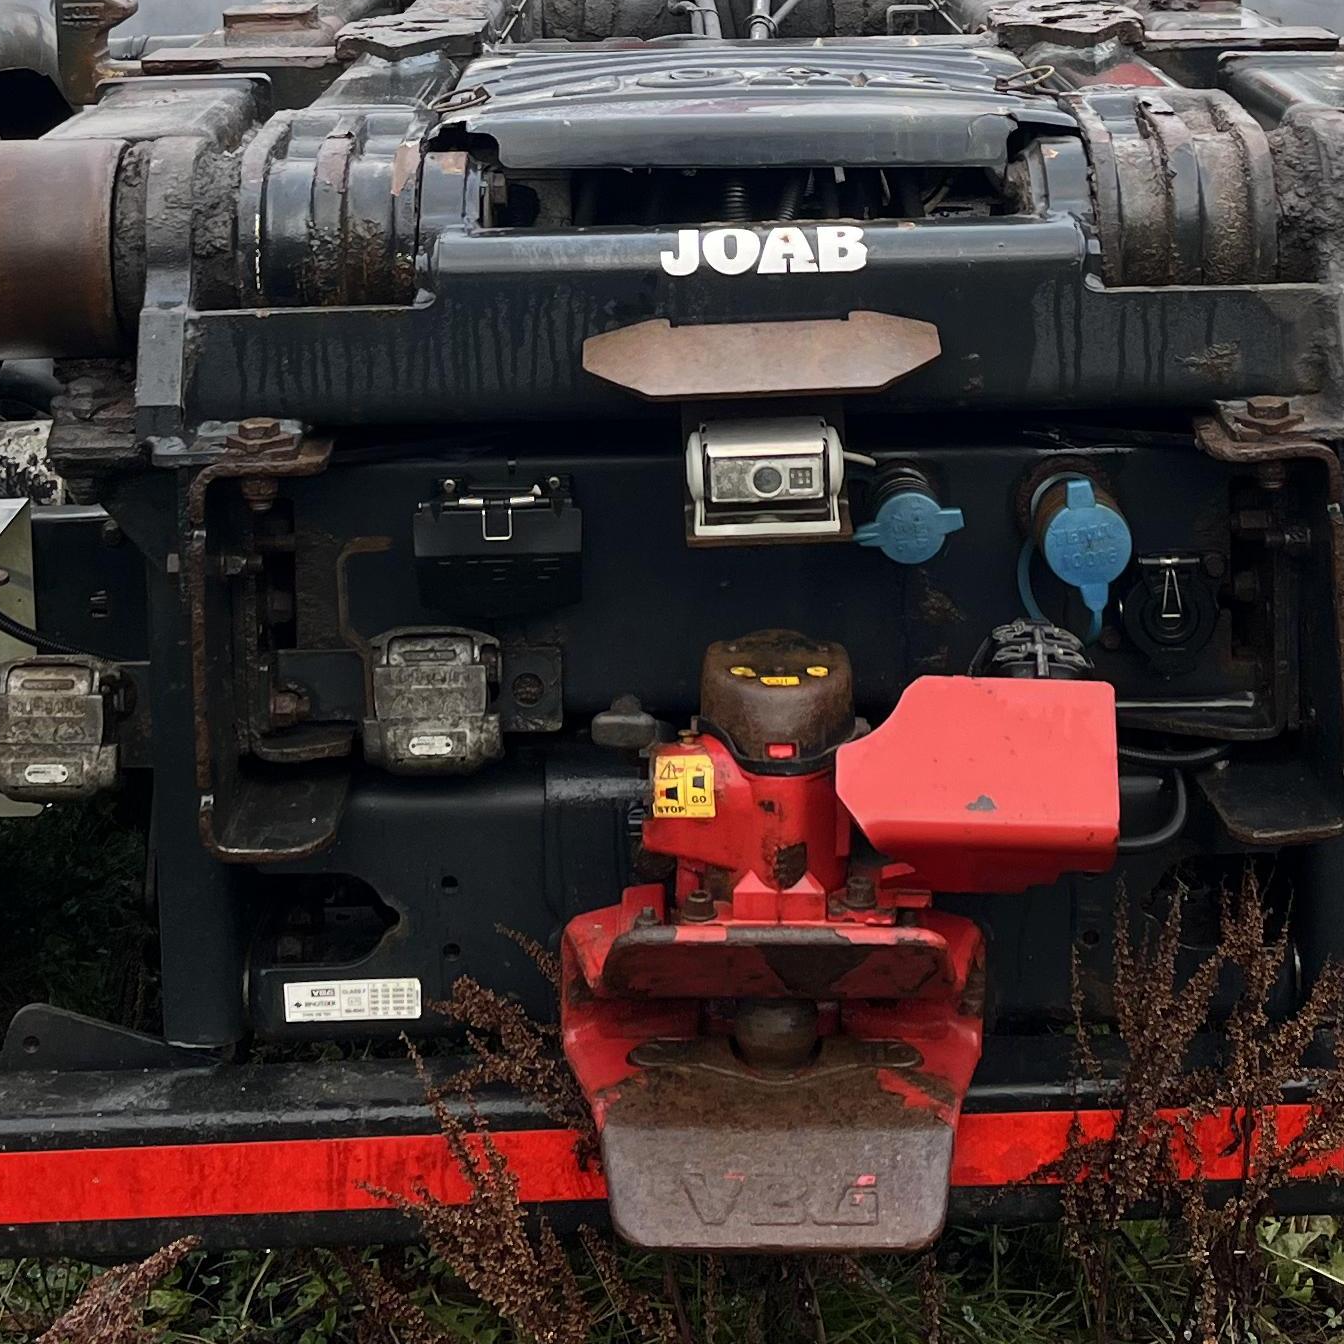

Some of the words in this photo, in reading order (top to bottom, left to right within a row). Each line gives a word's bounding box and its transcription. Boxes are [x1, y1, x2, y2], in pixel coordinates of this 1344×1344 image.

[660, 225, 868, 276] JOAB
[691, 795, 707, 804] GO
[657, 805, 685, 814] STOP
